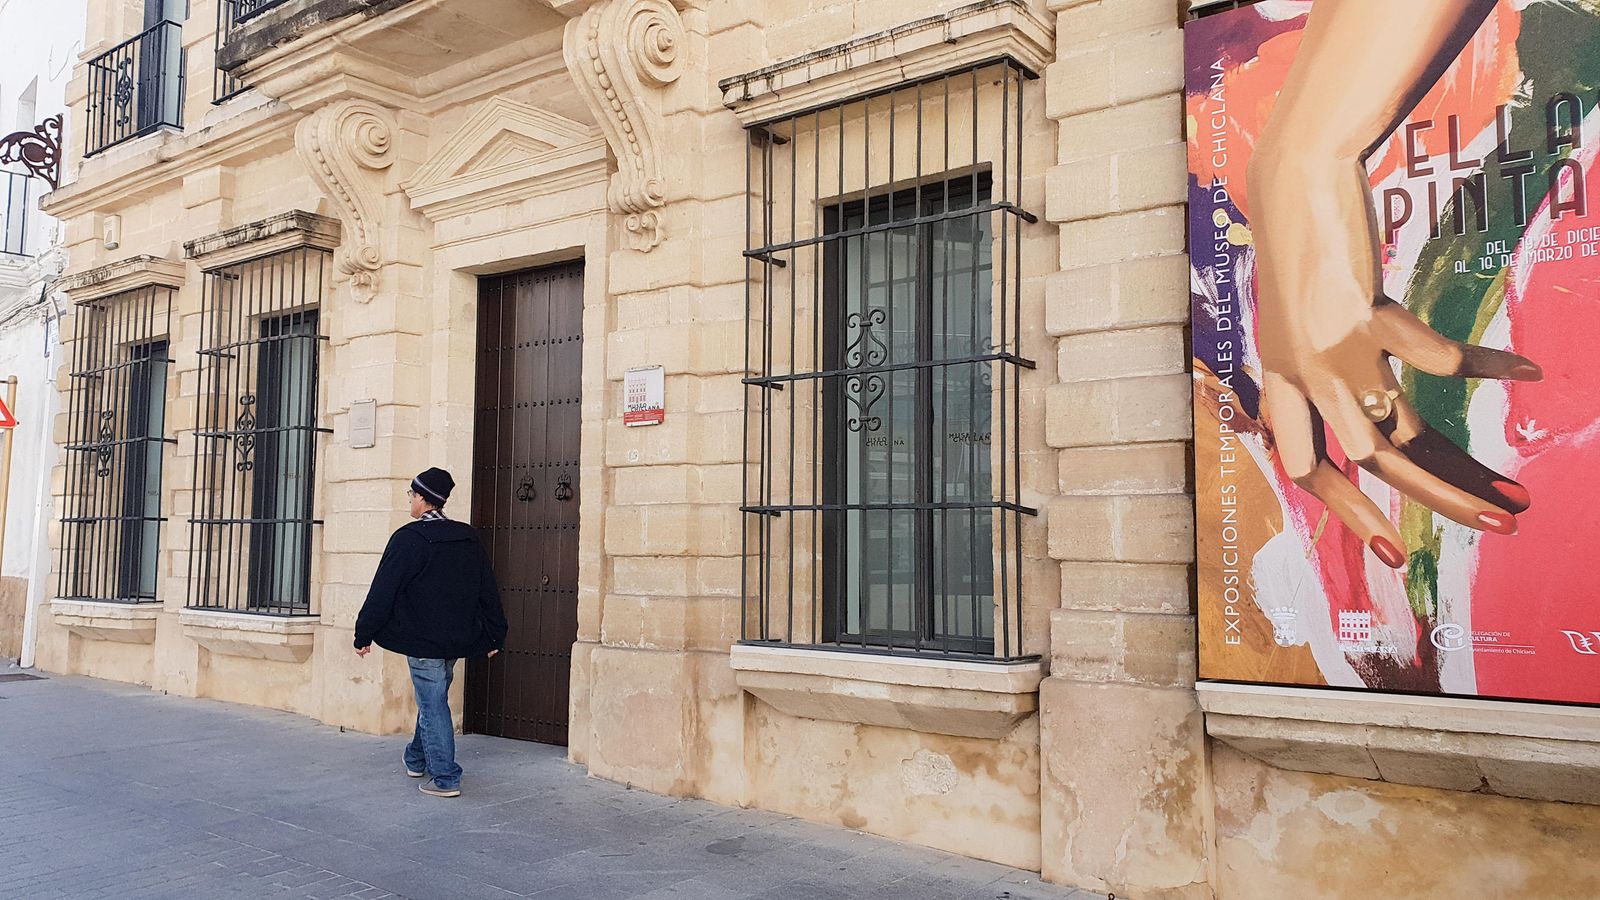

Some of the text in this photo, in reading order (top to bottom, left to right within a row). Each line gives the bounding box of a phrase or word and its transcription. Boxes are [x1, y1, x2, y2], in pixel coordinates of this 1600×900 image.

[1406, 91, 1600, 179] ELLA
[1383, 157, 1588, 245] PINTA
[1486, 240, 1511, 256] DEL
[1542, 232, 1559, 248] DE
[1567, 226, 1600, 245] DICIE
[1454, 241, 1599, 274] AL 10 DE MARZO DE
[1210, 56, 1241, 645] EXPOSICIONES TEMPORALES DEL MUSEO DE CHICLANA
